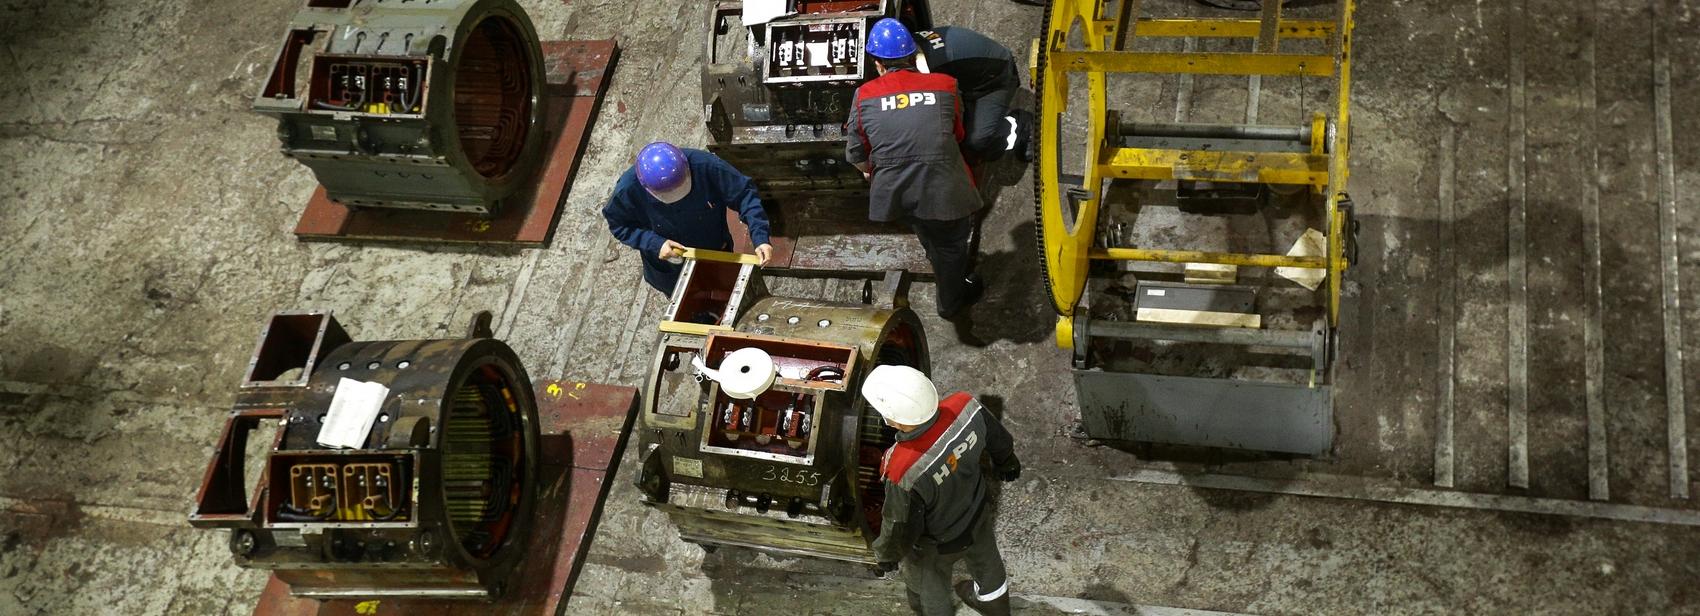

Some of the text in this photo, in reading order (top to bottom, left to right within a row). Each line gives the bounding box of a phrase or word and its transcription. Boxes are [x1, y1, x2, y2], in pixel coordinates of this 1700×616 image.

[915, 31, 945, 49] НЭР
[881, 92, 936, 111] НЭРЗ
[932, 430, 978, 486] НЭРЗ
[762, 465, 822, 486] 3255
